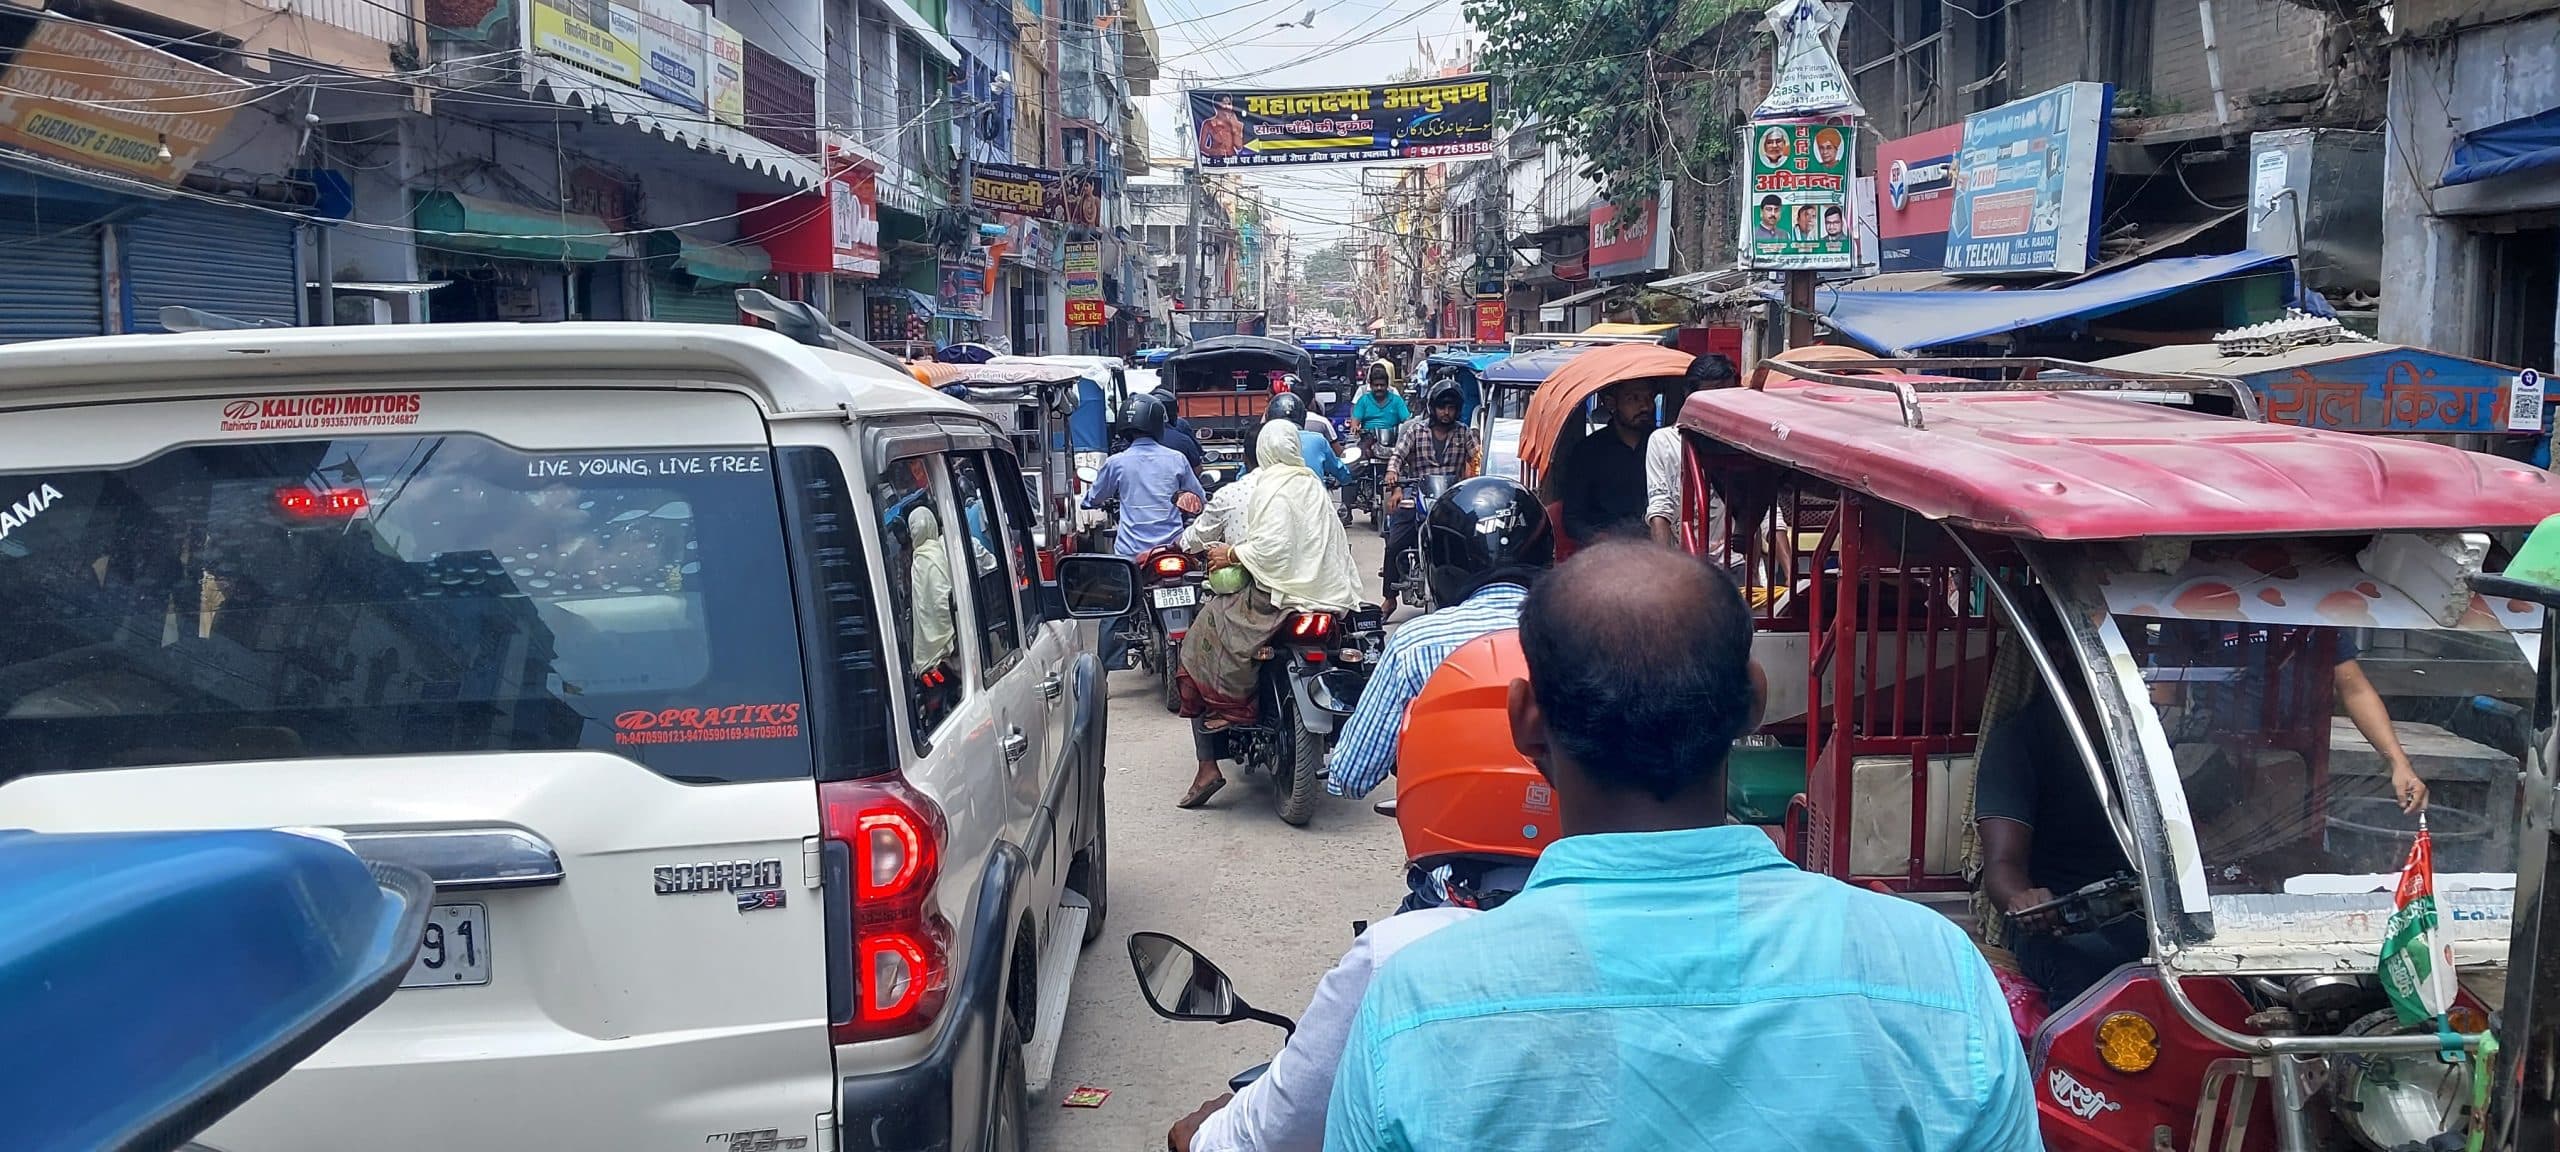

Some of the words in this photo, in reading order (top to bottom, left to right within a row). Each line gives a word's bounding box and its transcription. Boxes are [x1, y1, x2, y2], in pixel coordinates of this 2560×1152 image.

[34, 23, 134, 72] RAJENDRA
[1804, 81, 1815, 93] N
[1820, 79, 1842, 93] Ply
[26, 114, 97, 148] CHEMIST
[94, 134, 104, 149] &
[1316, 117, 1334, 133] की
[1336, 118, 1374, 136] दुकान
[1756, 170, 1843, 191] अभिनन्दन
[1944, 245, 1962, 268] N.K.
[1965, 241, 2010, 267] TELECOM
[2010, 252, 2027, 265] SALES
[2032, 249, 2056, 264] SERVICE
[2381, 361, 2491, 427] किंग
[261, 395, 421, 417] KALI(CH)MOTORS
[221, 420, 257, 431] Mahindra
[260, 419, 303, 429] DALKHOLA
[528, 460, 572, 476] LIVE
[579, 459, 652, 476] YOUNG,
[659, 457, 704, 474] LIVE
[709, 456, 764, 473] FREE
[0, 483, 64, 540] AMA
[658, 704, 800, 728] PRATIK'S
[654, 858, 782, 895] SCORPIO
